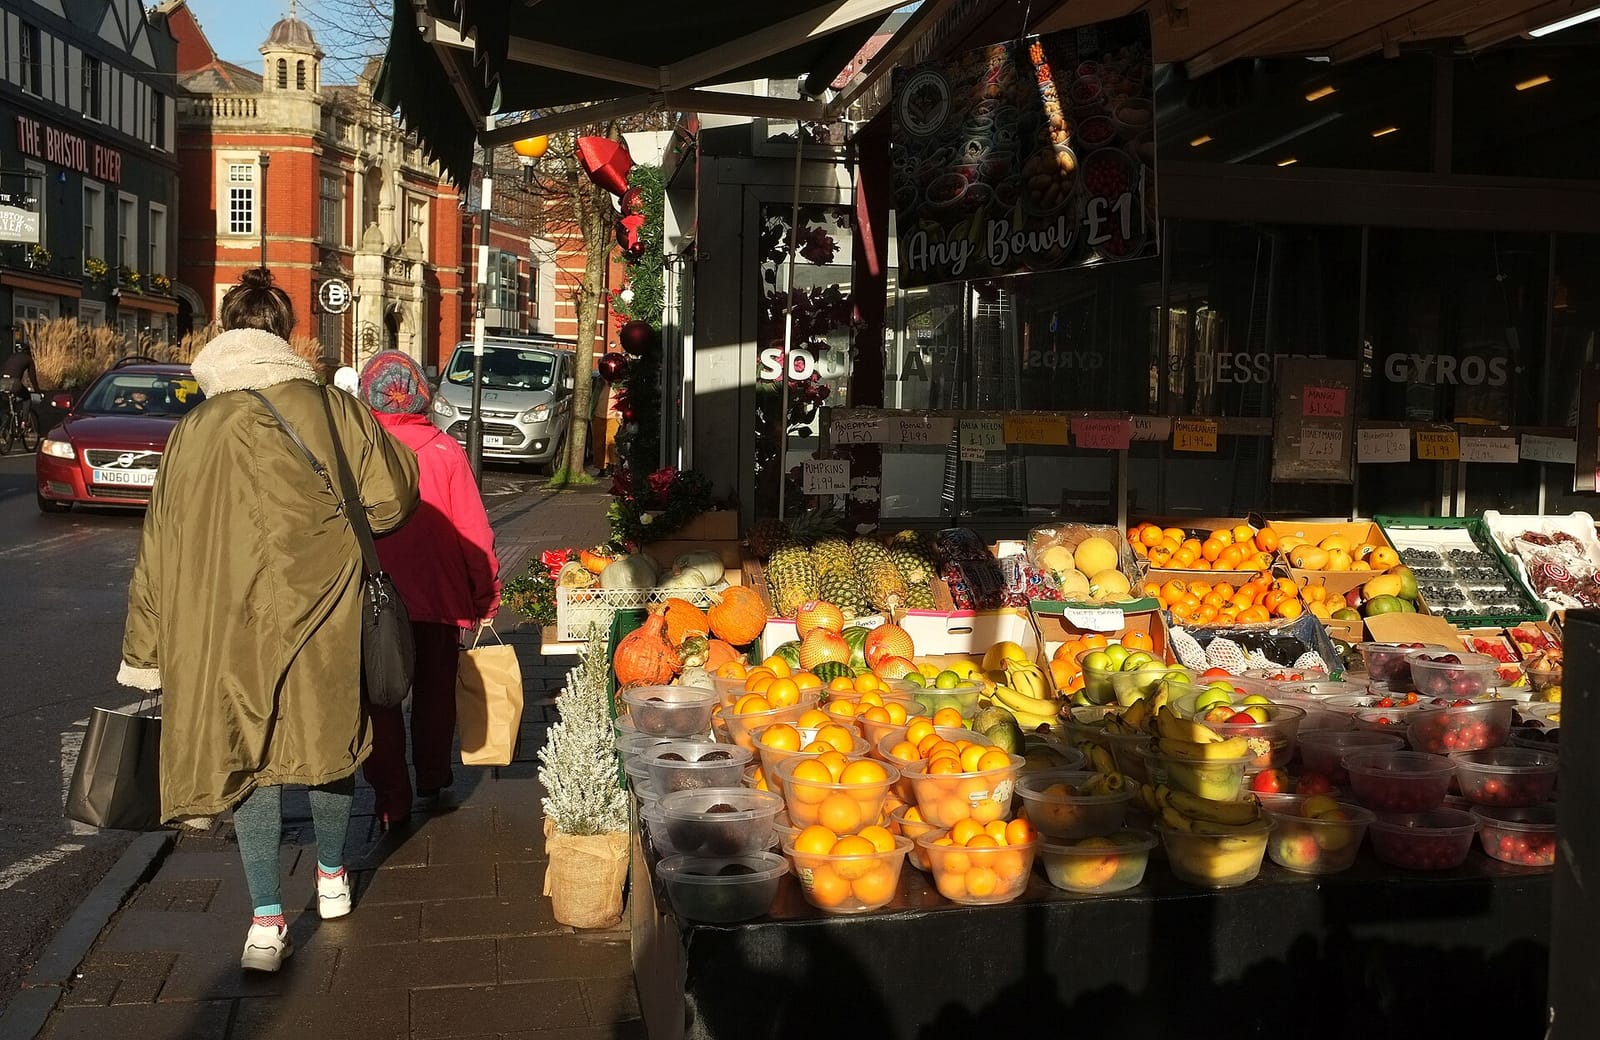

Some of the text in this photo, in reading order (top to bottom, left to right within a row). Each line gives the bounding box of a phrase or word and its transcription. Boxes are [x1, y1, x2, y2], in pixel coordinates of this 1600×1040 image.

[17, 115, 121, 185] THE BRISTOL FLYER
[908, 192, 1132, 276] Any Bowl £1
[1384, 352, 1508, 387] GYROS
[805, 462, 845, 474] PUMPKINS
